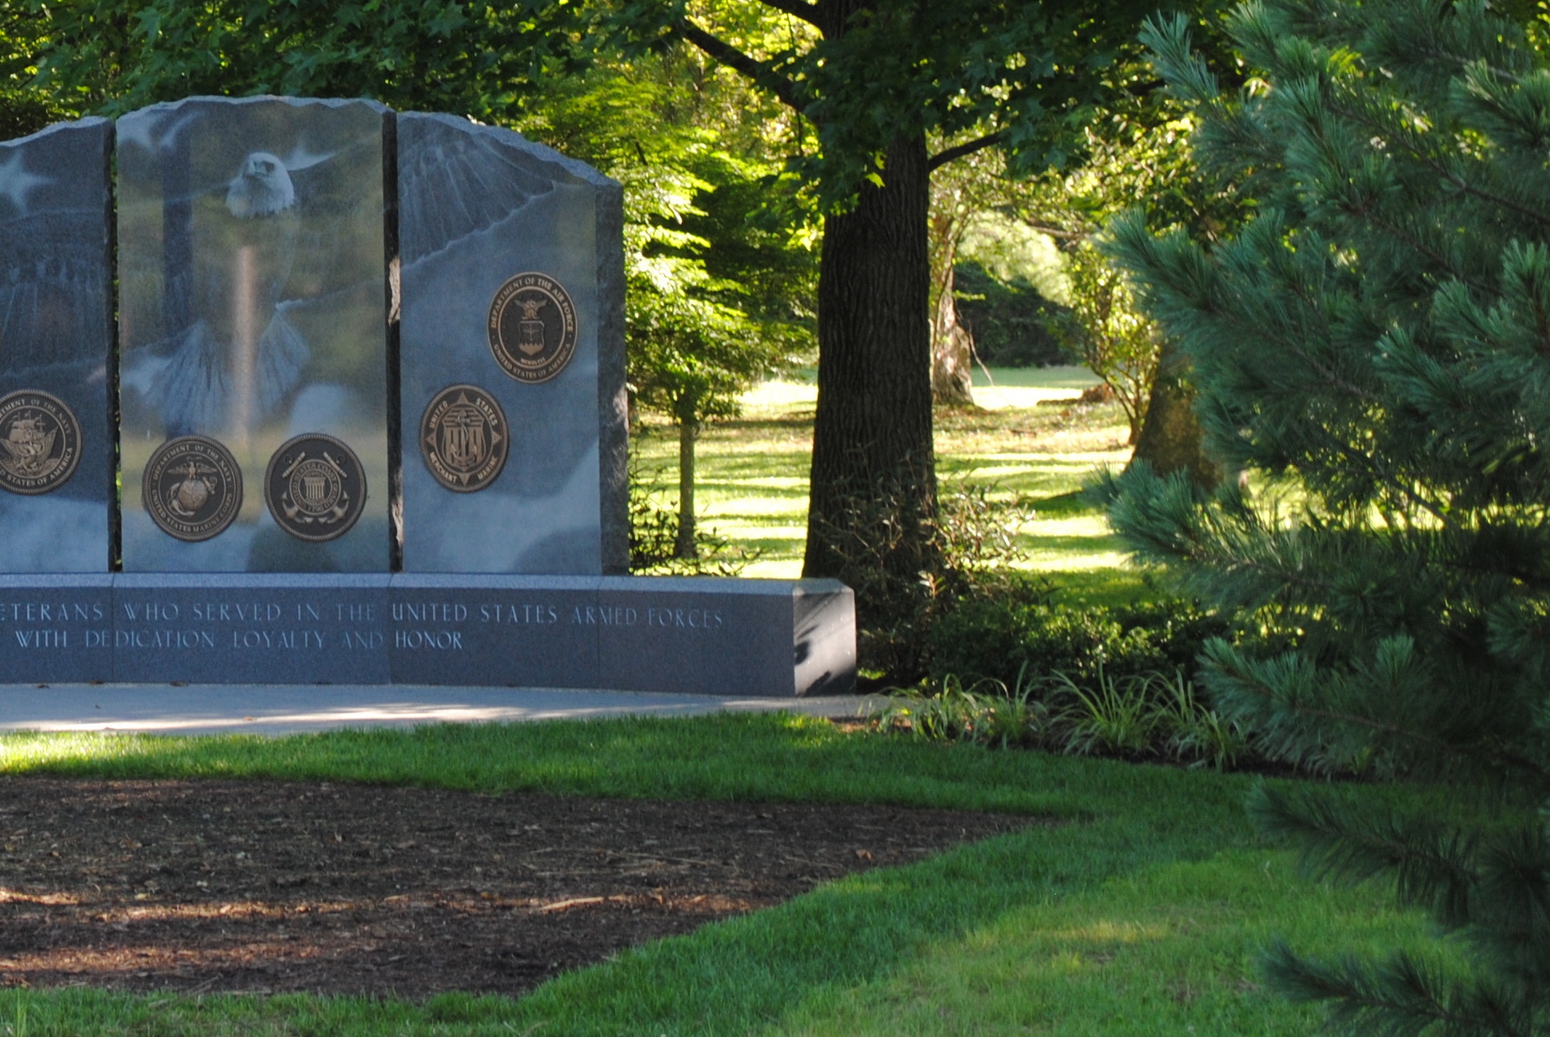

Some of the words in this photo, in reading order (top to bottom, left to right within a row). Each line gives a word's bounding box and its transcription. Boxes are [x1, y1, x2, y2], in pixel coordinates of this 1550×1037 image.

[491, 280, 523, 329] DEPARTMENT
[525, 277, 536, 285] OF
[537, 278, 553, 290] THE
[552, 288, 565, 302] AIR
[562, 302, 574, 332] FORCE
[494, 344, 513, 370] UNITED
[513, 367, 537, 378] STATES
[538, 369, 547, 377] OF
[548, 343, 571, 371] AMERICA
[44, 402, 57, 413] THE
[429, 400, 448, 429] UNITED
[475, 397, 498, 426] STATES
[7, 475, 35, 486] STATES
[37, 477, 48, 485] OF
[50, 447, 73, 480] AMERICA
[153, 445, 190, 480] DEPARTMENT
[207, 449, 219, 460] THE
[430, 451, 458, 484] MERCHANT
[477, 455, 500, 480] MARINE
[152, 490, 167, 518] UNITED
[167, 517, 191, 532] STATES
[123, 603, 179, 621] WHO
[193, 603, 281, 621] SERVED
[297, 603, 320, 621] IN
[336, 603, 375, 621] THE
[392, 603, 467, 622] UNITED
[480, 605, 558, 624] STATES
[571, 606, 637, 626] ARMED
[648, 608, 723, 628] FORCES
[15, 630, 67, 648] WITH
[85, 630, 214, 648] DEDICATION
[233, 630, 326, 649] LOYALTY
[341, 630, 384, 649] AND
[395, 630, 462, 650] HONOR
